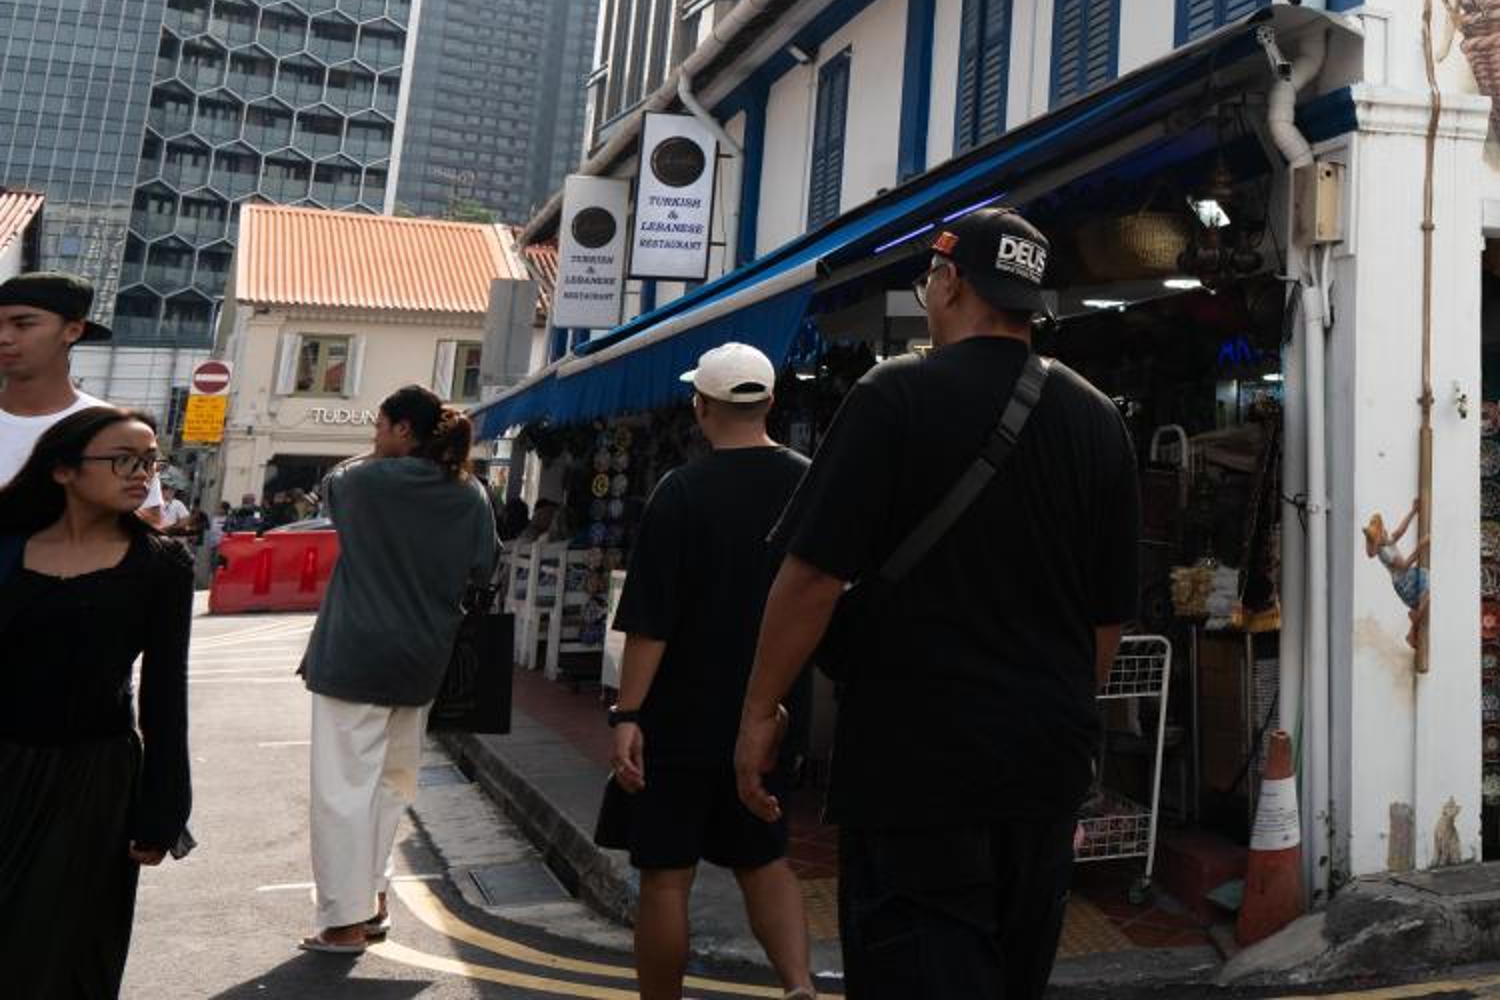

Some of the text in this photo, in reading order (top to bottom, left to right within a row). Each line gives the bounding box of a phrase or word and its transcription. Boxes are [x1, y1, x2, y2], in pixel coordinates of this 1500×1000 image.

[649, 195, 702, 208] TURKISH
[667, 210, 679, 220] &
[640, 221, 704, 234] LEBANESE
[639, 239, 702, 250] RESTAURANT
[998, 237, 1046, 274] DEUS
